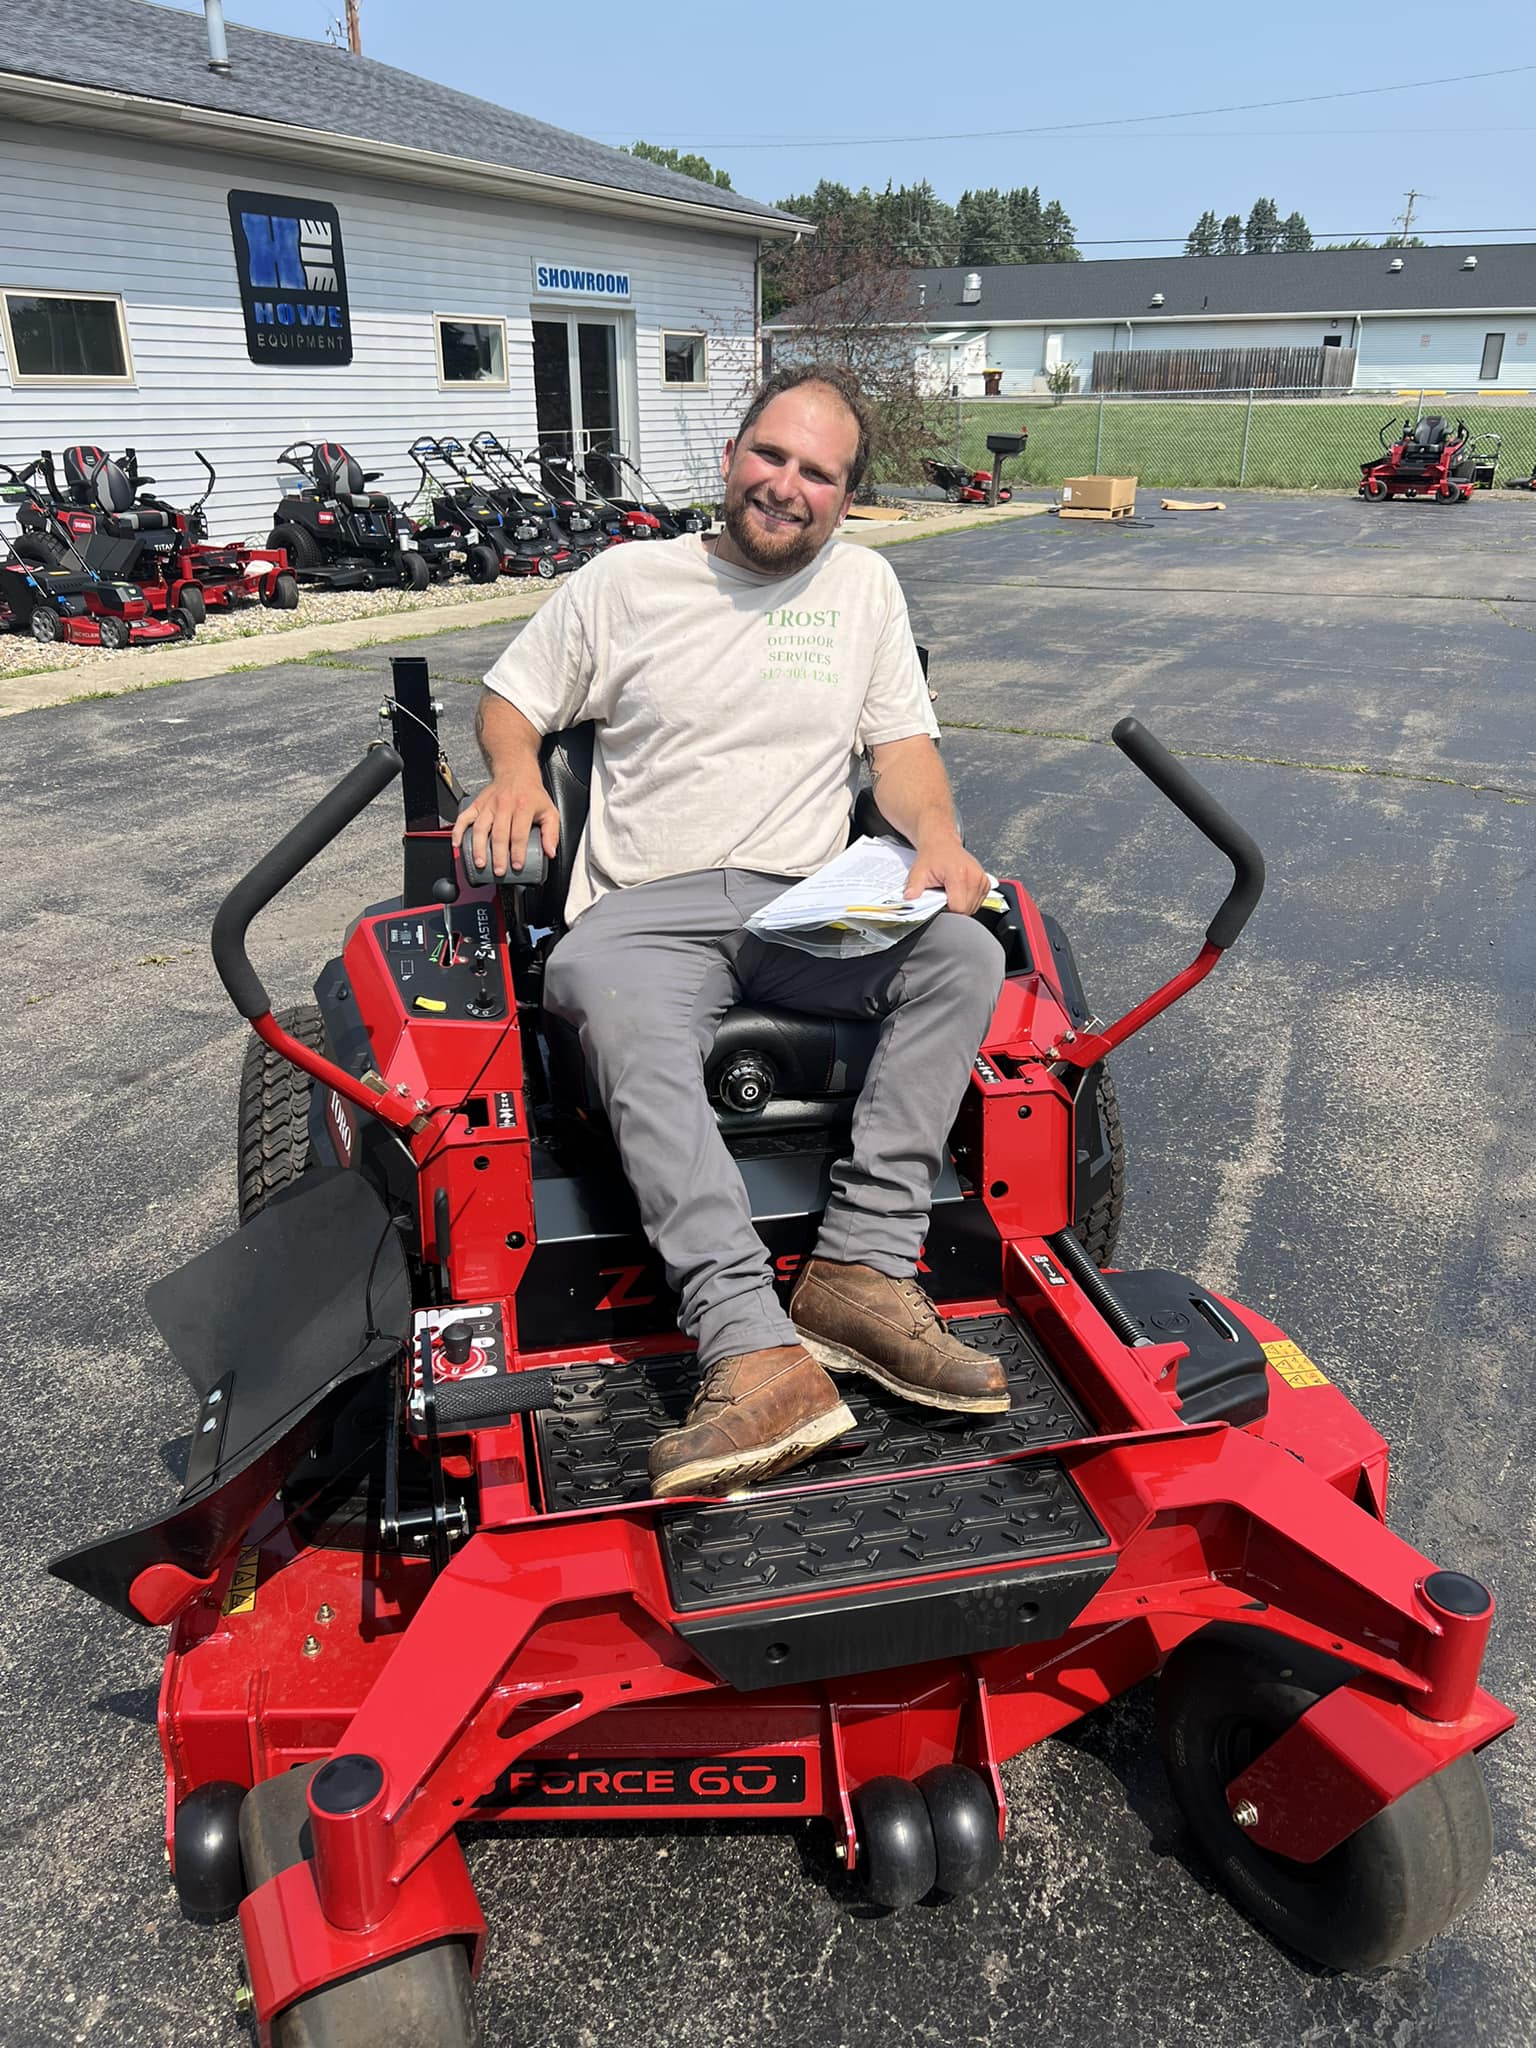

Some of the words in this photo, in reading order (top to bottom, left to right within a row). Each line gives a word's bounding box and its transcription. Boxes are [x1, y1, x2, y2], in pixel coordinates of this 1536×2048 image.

[537, 266, 629, 295] SHOWROOM
[254, 302, 343, 328] HOWE
[257, 333, 344, 350] EQUIPMENT
[765, 609, 841, 628] TROST
[768, 635, 834, 648] OUTDOOR
[769, 651, 831, 665] SERVICES
[476, 908, 493, 950] MASTER
[594, 1264, 656, 1311] Z
[509, 1769, 675, 1795] FORCE
[689, 1765, 777, 1796] 60
